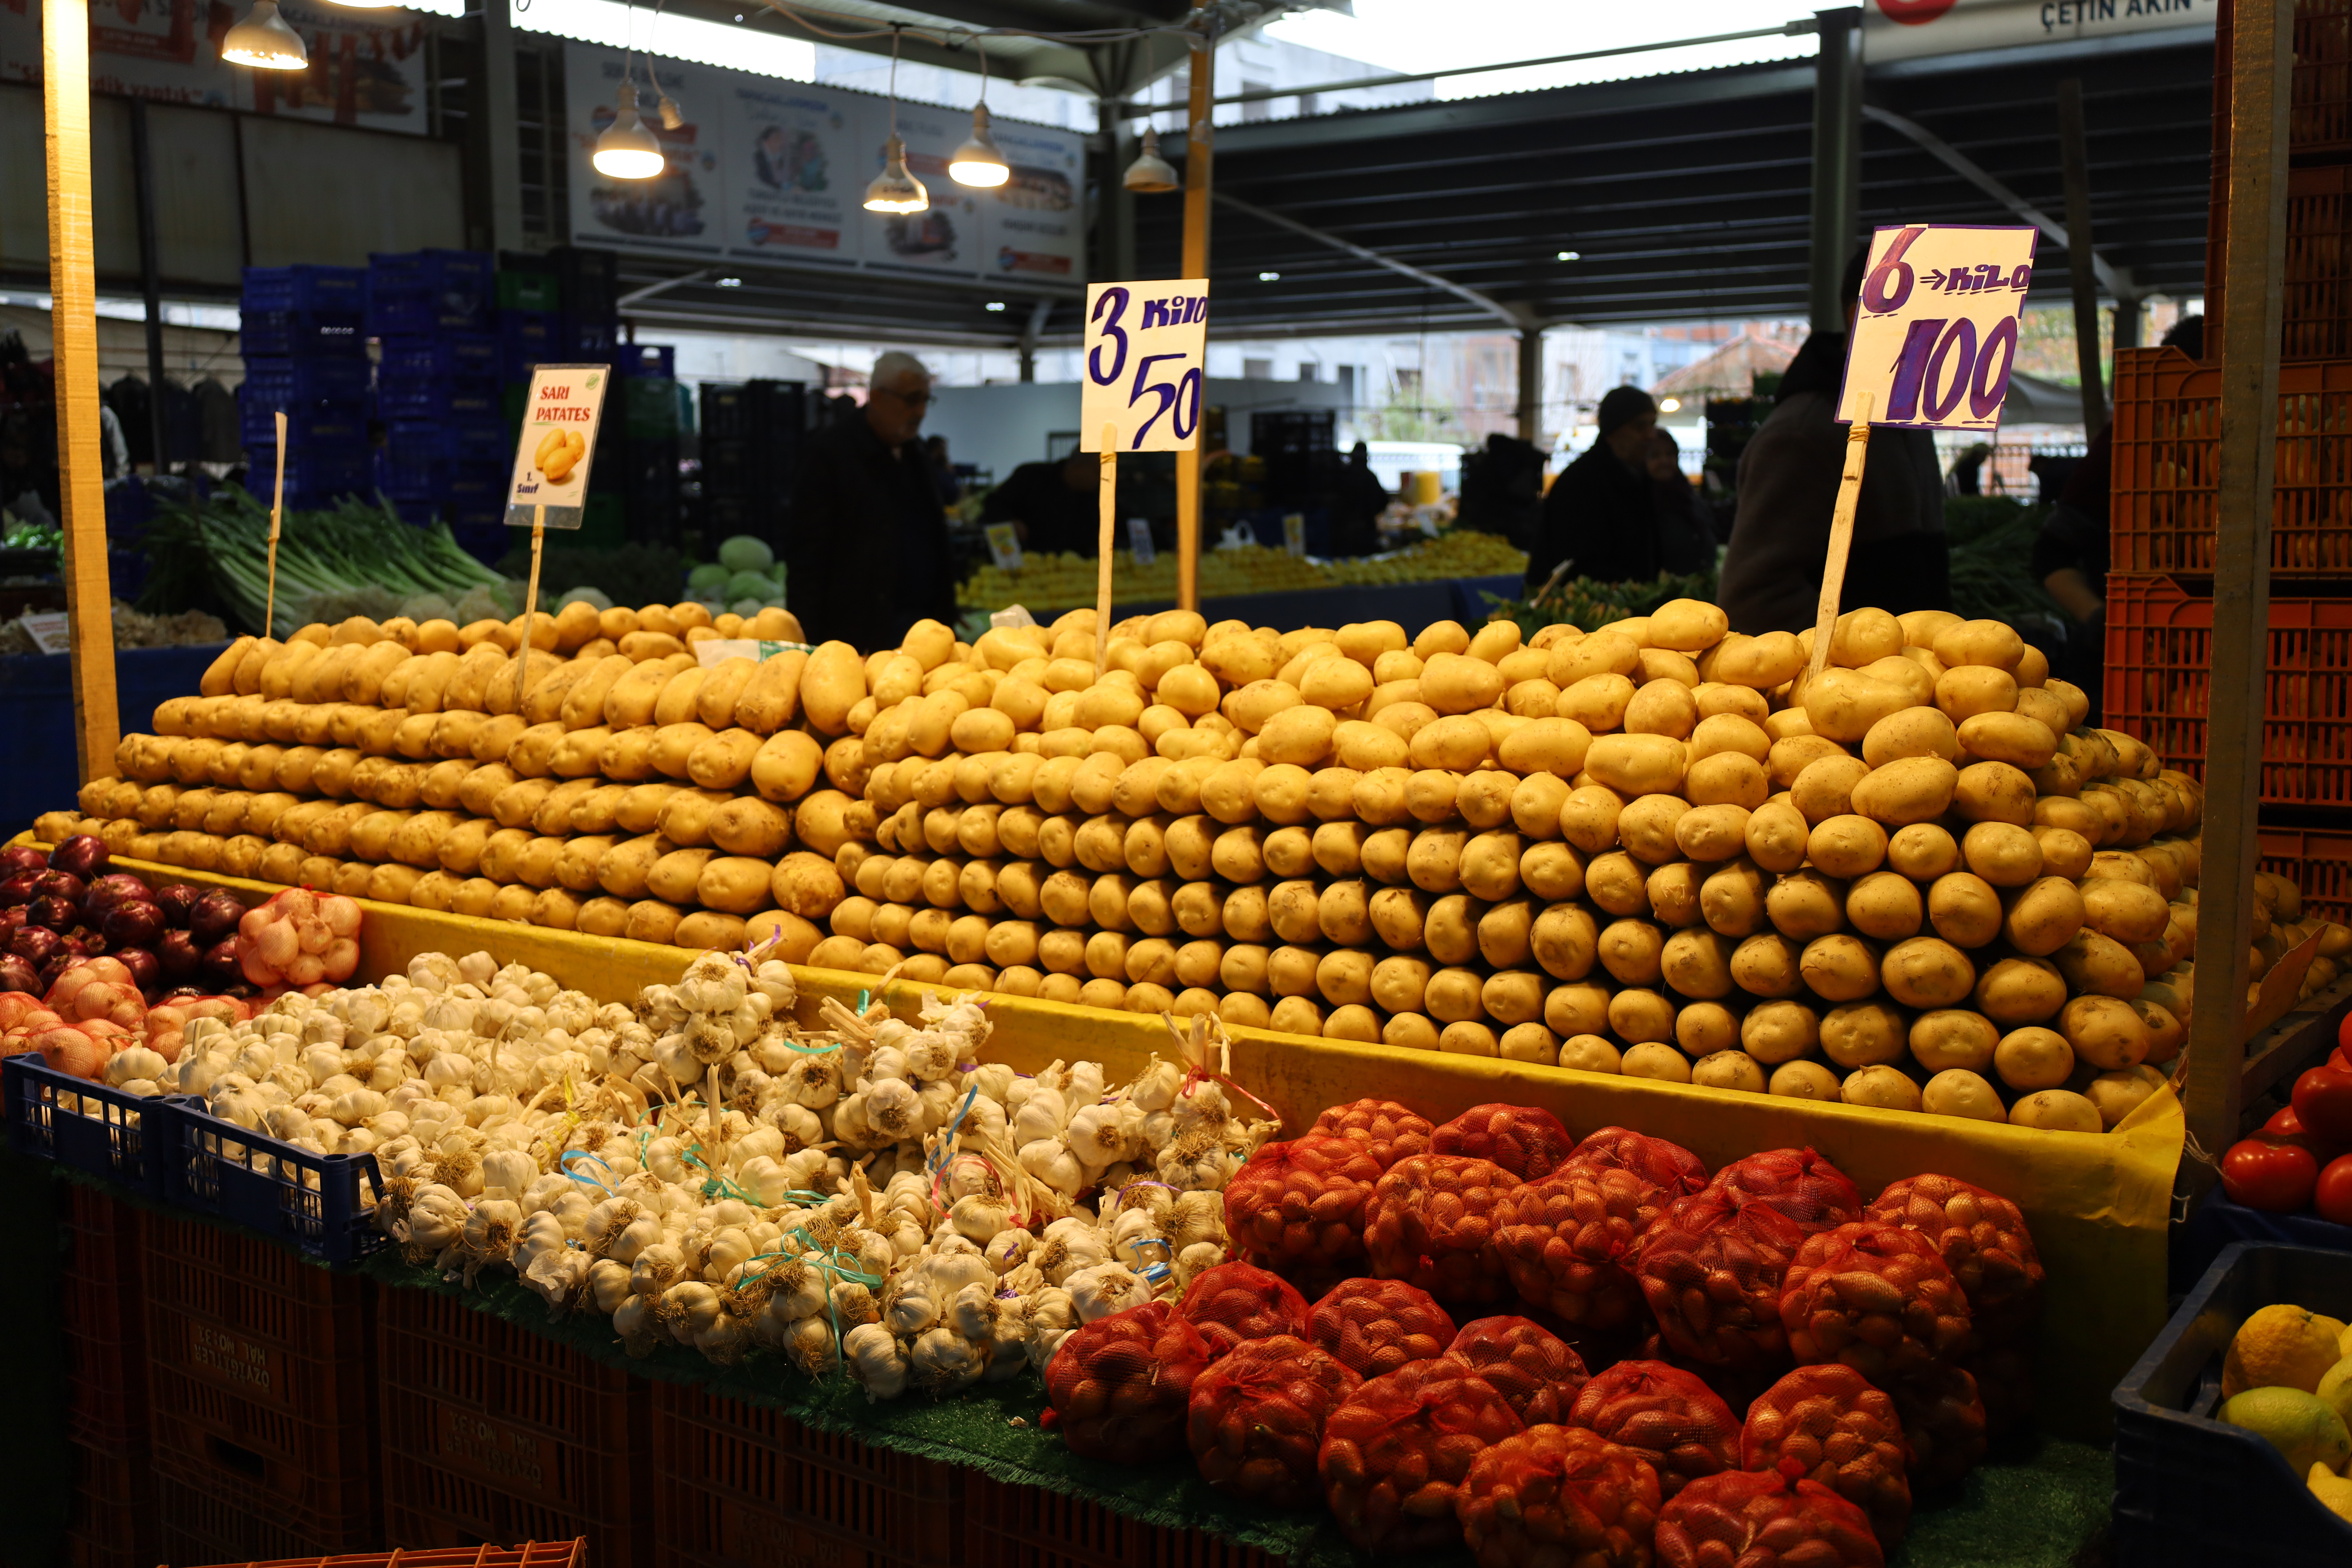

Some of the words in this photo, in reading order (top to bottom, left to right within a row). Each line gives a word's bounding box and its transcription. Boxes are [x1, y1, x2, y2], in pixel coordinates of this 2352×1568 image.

[1862, 227, 1925, 314] 6
[1089, 287, 1129, 386] 3
[1886, 315, 2017, 421] 100
[540, 386, 570, 400] SARI
[1129, 353, 1201, 450] 50
[536, 407, 590, 421] PATATES
[526, 472, 532, 482] 1.
[198, 1325, 235, 1354] NO:31
[242, 1341, 266, 1366] HAL
[450, 1411, 498, 1446] NO:31
[507, 1431, 537, 1459] HAL
